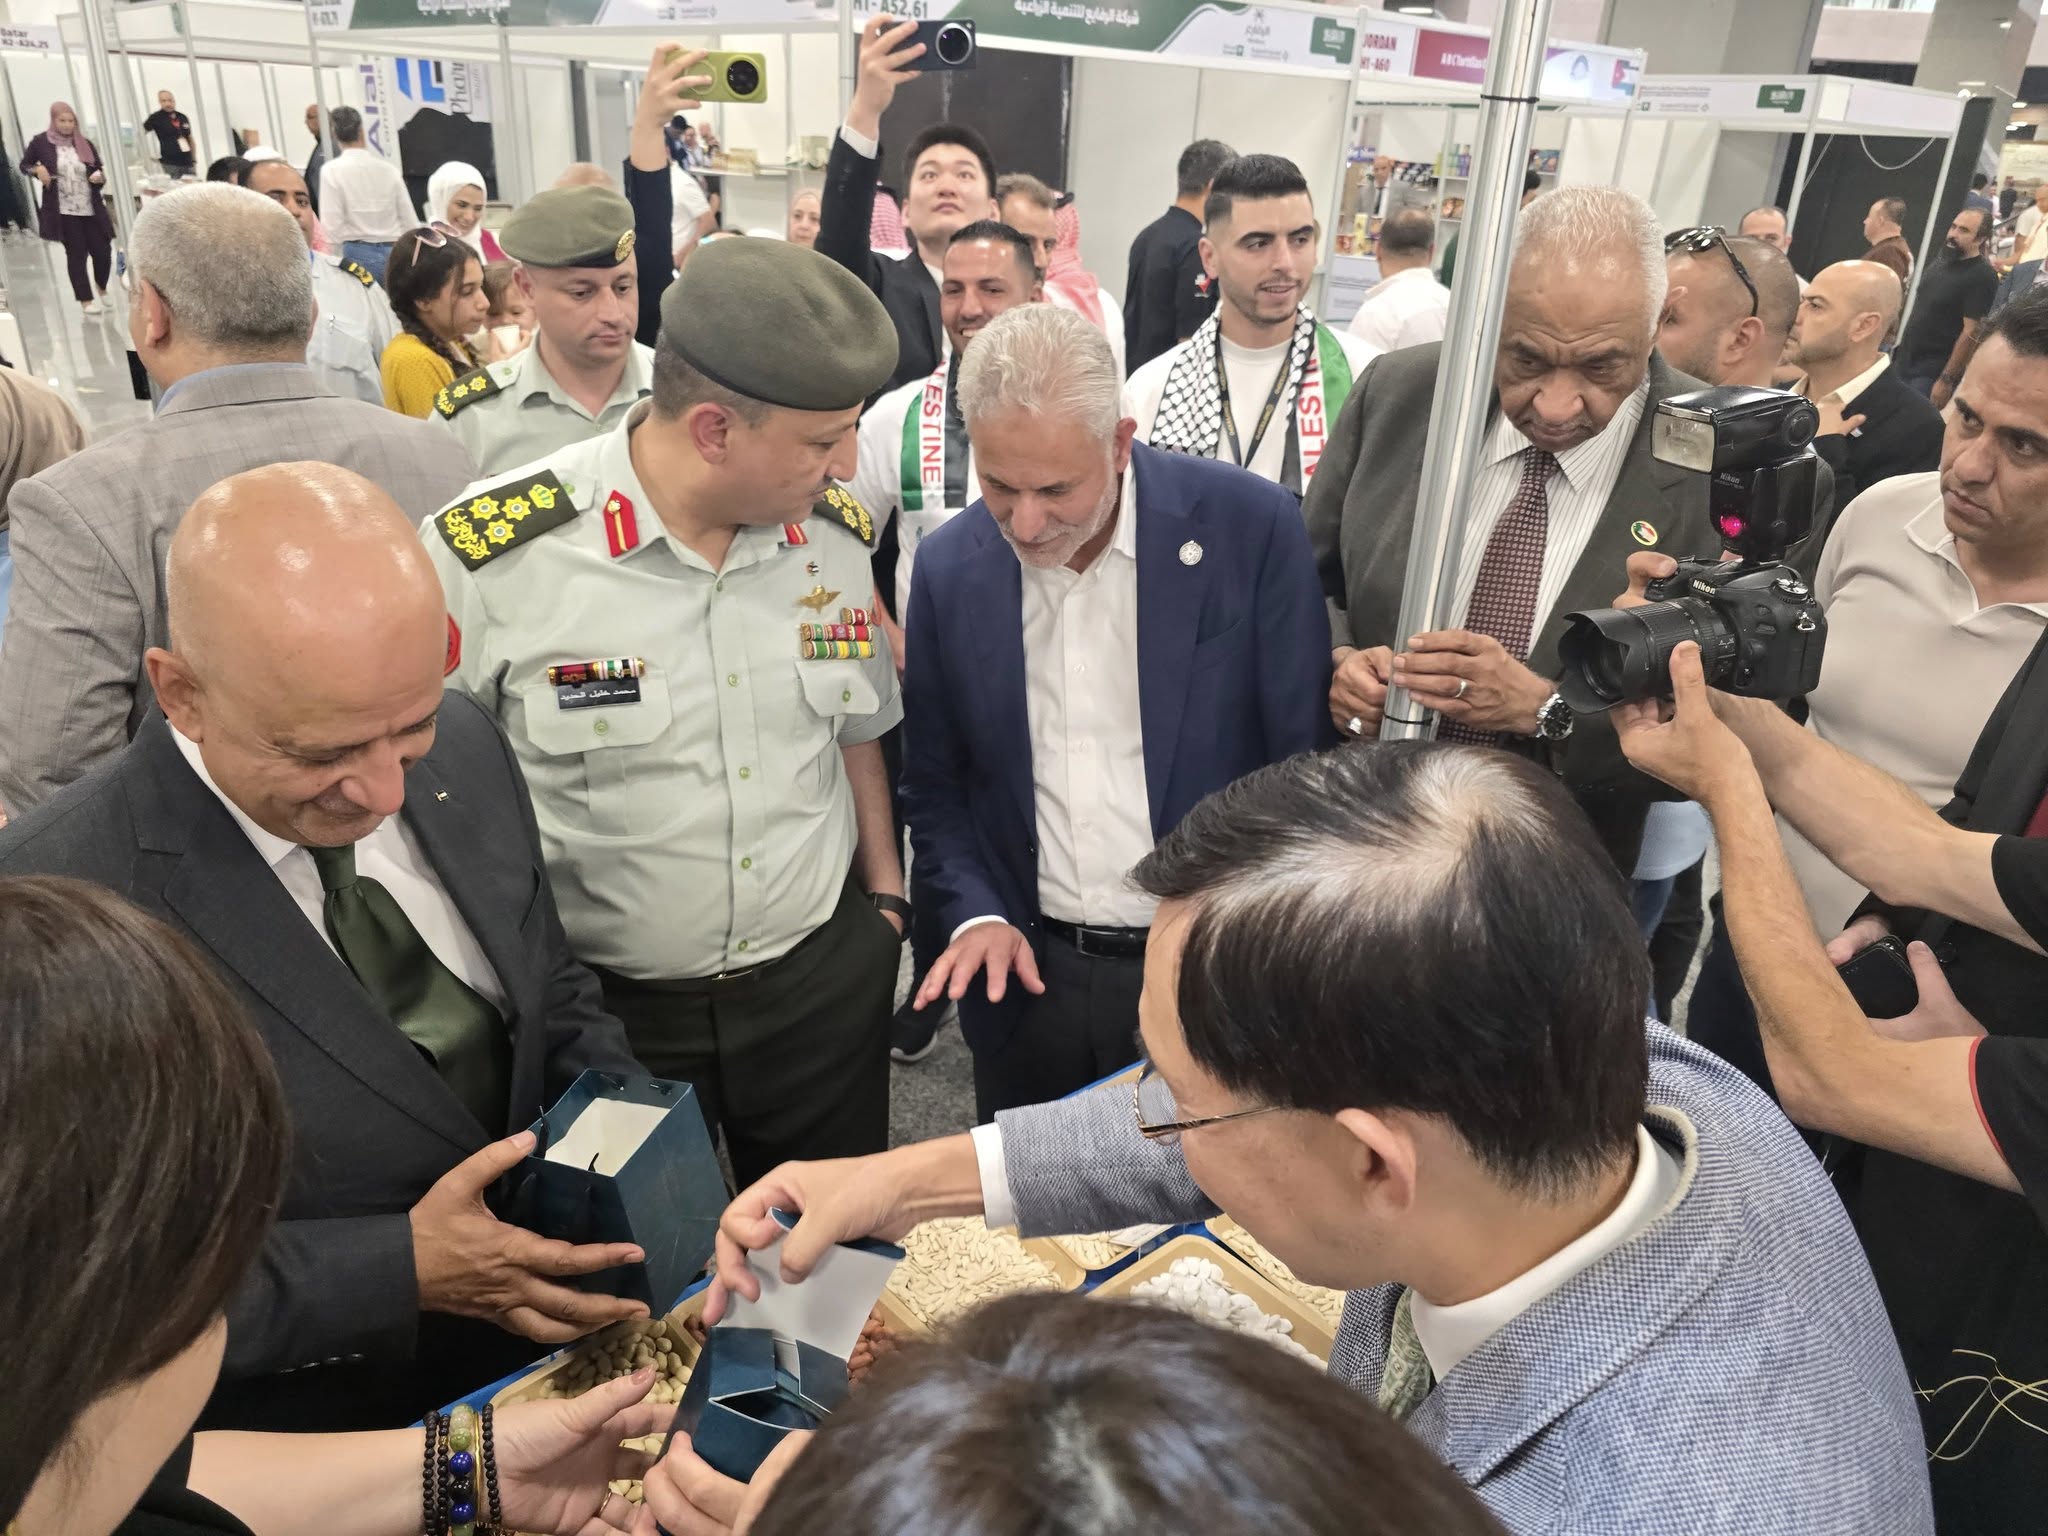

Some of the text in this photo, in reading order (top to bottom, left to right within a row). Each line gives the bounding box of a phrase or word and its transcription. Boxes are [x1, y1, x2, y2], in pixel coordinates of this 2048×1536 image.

[1362, 33, 1397, 51] JORDAN
[922, 360, 947, 484] LESTINE
[1720, 472, 1740, 484] Nikon
[1692, 579, 1716, 595] Nikon
[612, 688, 637, 696] محمد
